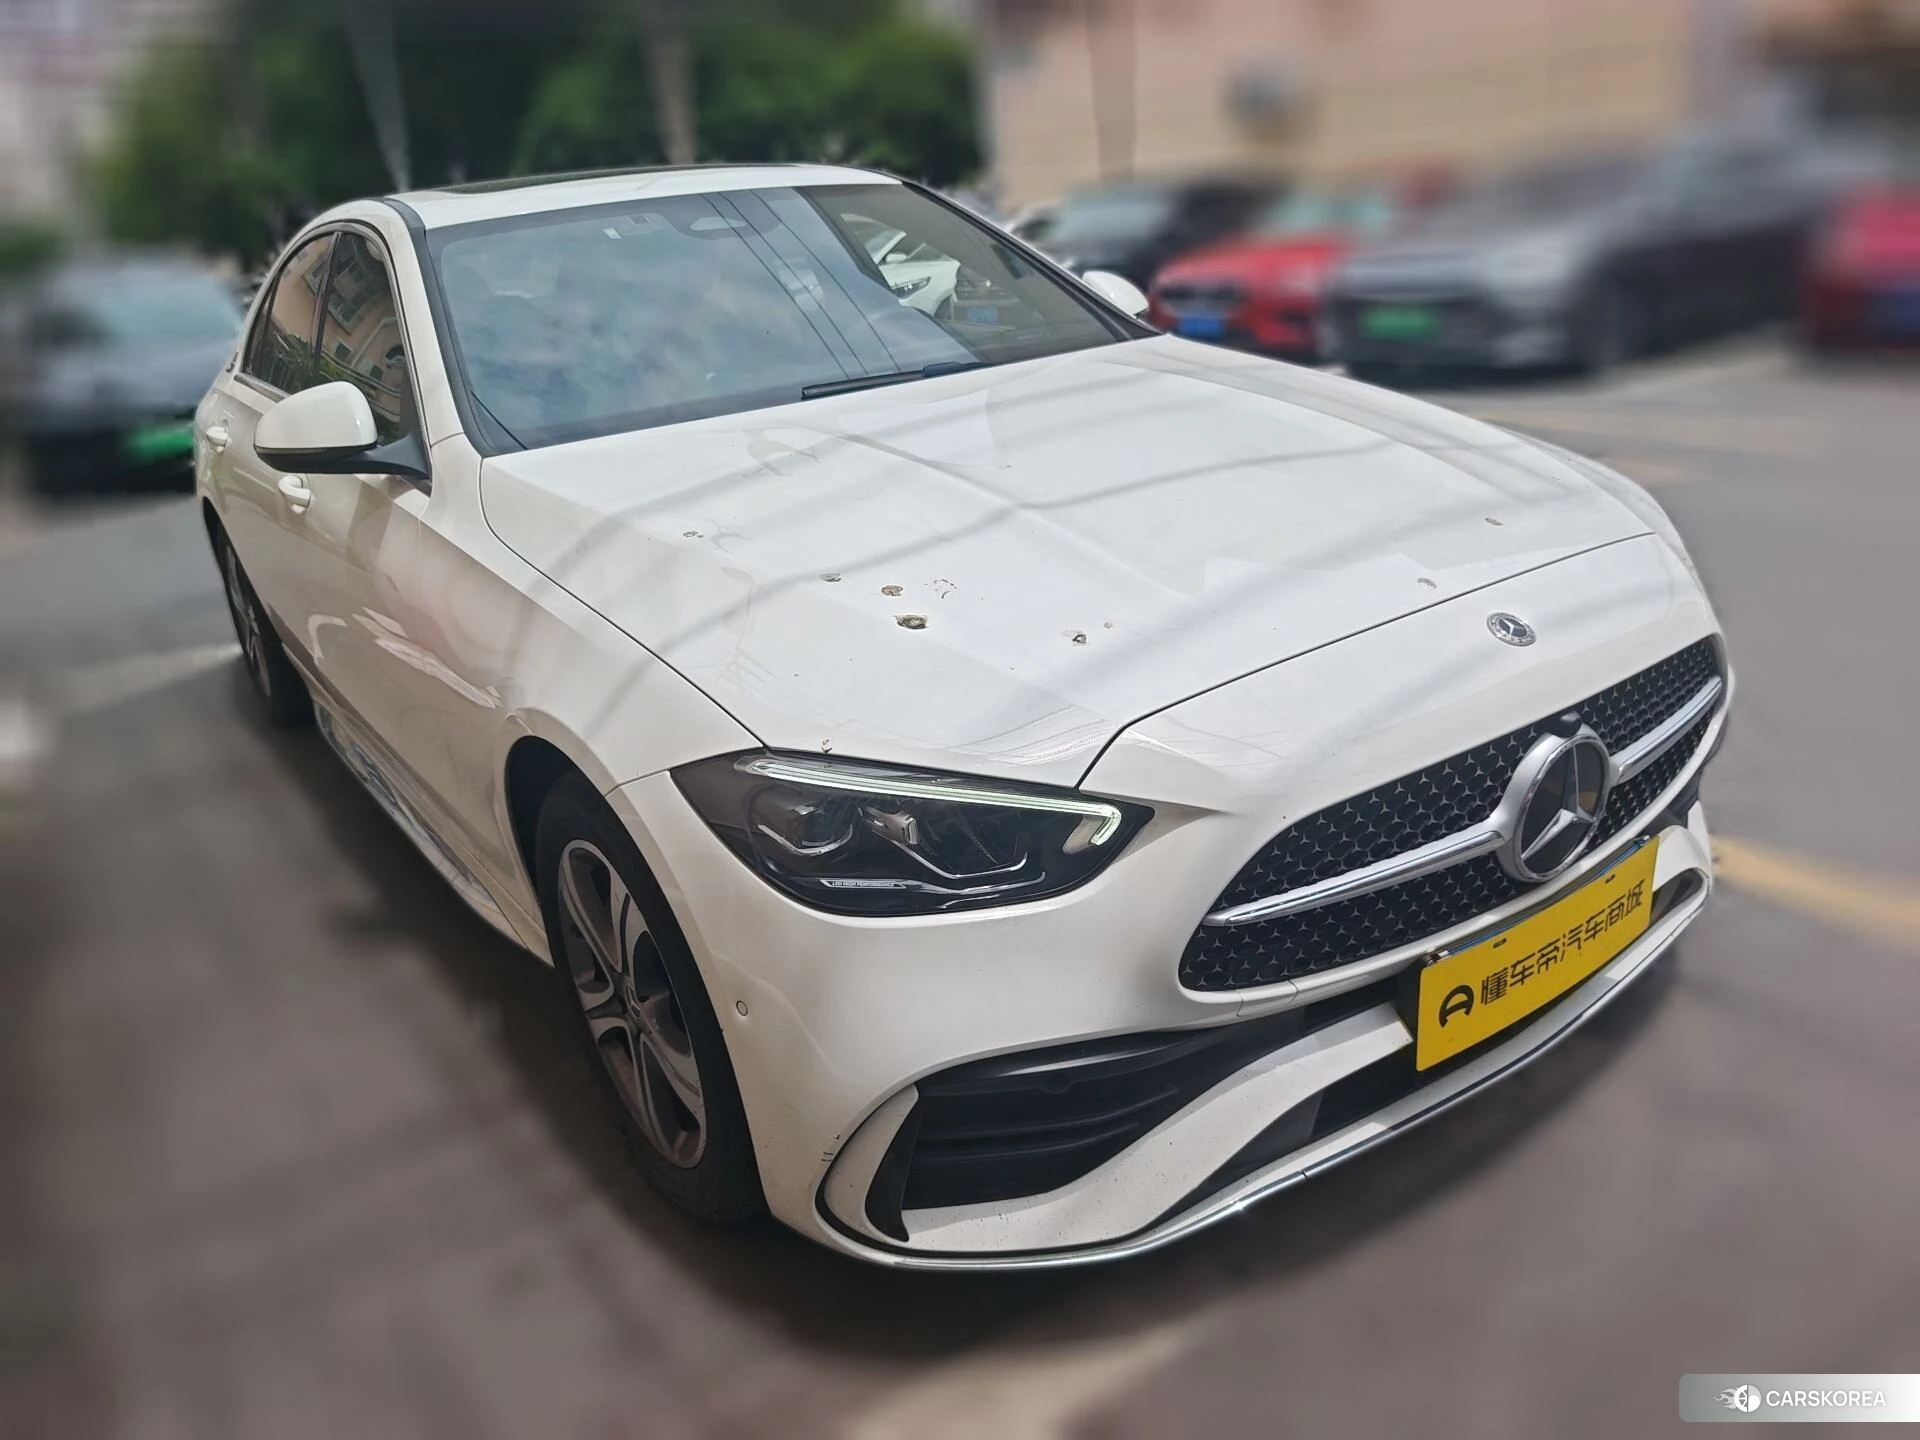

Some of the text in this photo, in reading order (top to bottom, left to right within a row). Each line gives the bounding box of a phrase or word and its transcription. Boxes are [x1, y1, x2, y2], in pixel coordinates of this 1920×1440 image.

[1480, 878, 1645, 1005] 懂车帝汽车商城
